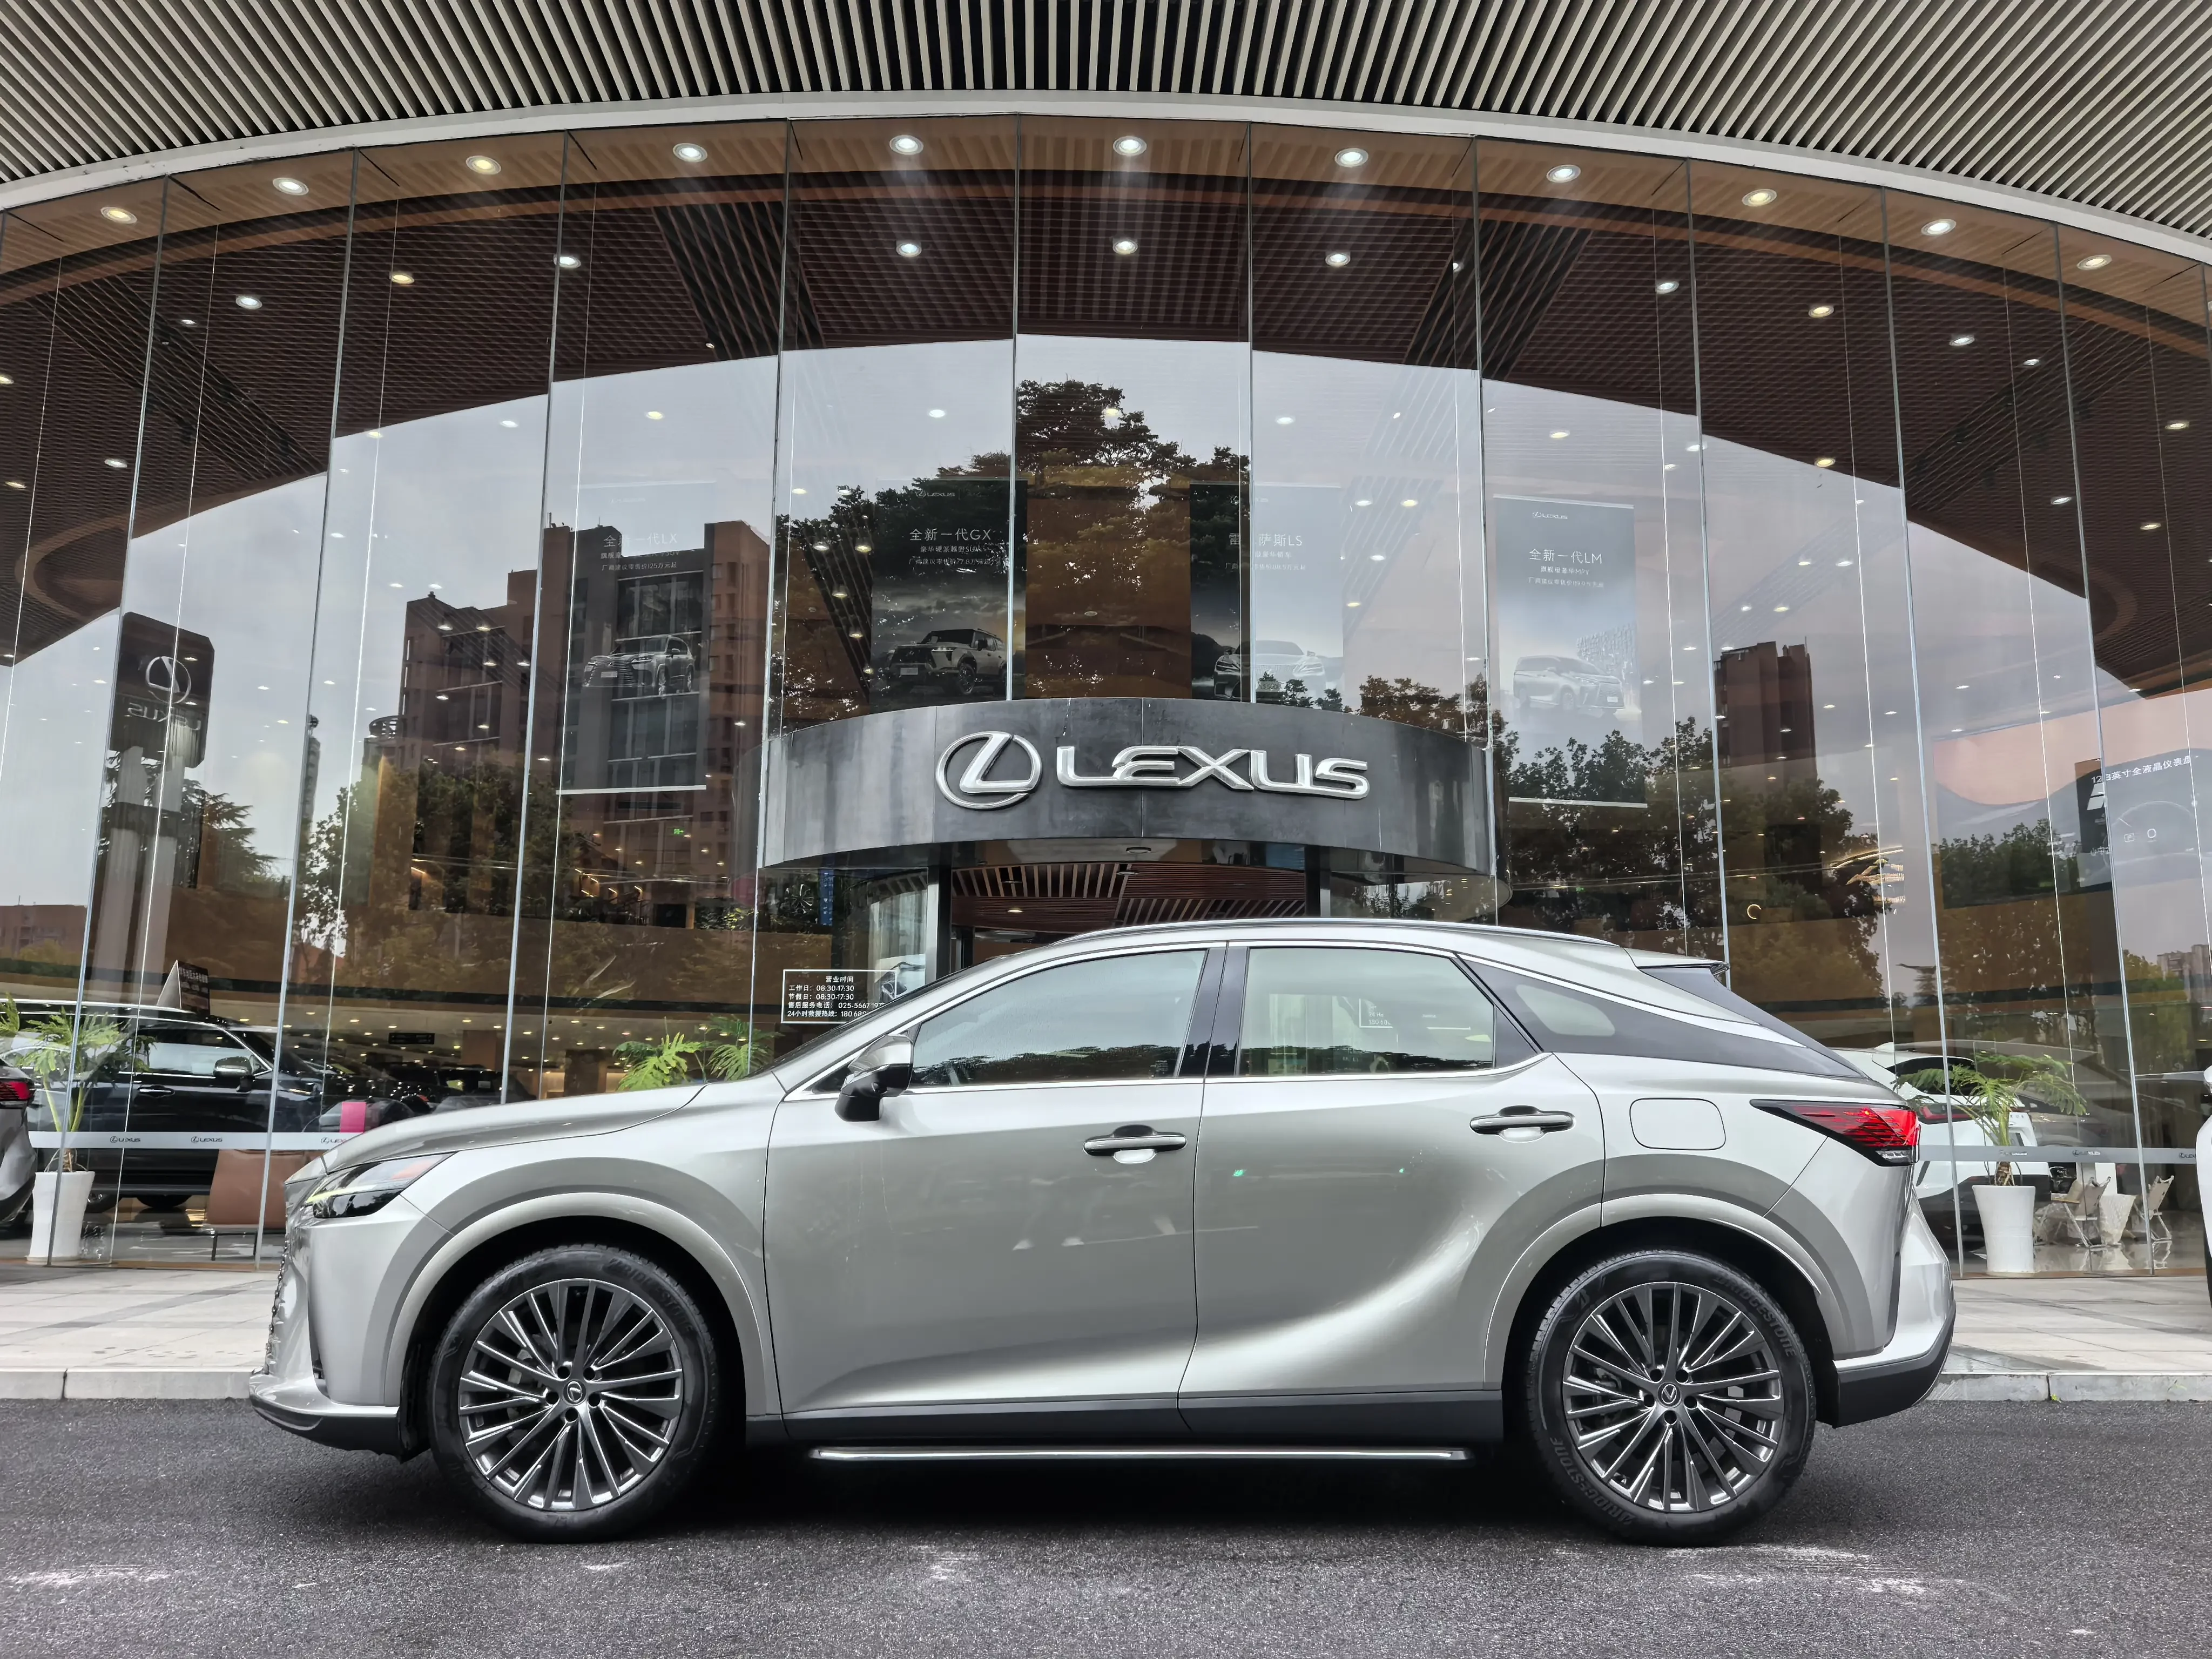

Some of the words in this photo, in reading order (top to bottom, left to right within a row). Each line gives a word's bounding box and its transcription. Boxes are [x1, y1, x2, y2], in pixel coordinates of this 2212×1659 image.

[603, 532, 678, 548] 全新一代LX
[909, 528, 992, 541] 全新一代GX
[1229, 532, 1303, 547] 雷萨斯LS
[1528, 548, 1603, 564] 全新一代LM
[1056, 745, 1371, 800] LEXUS
